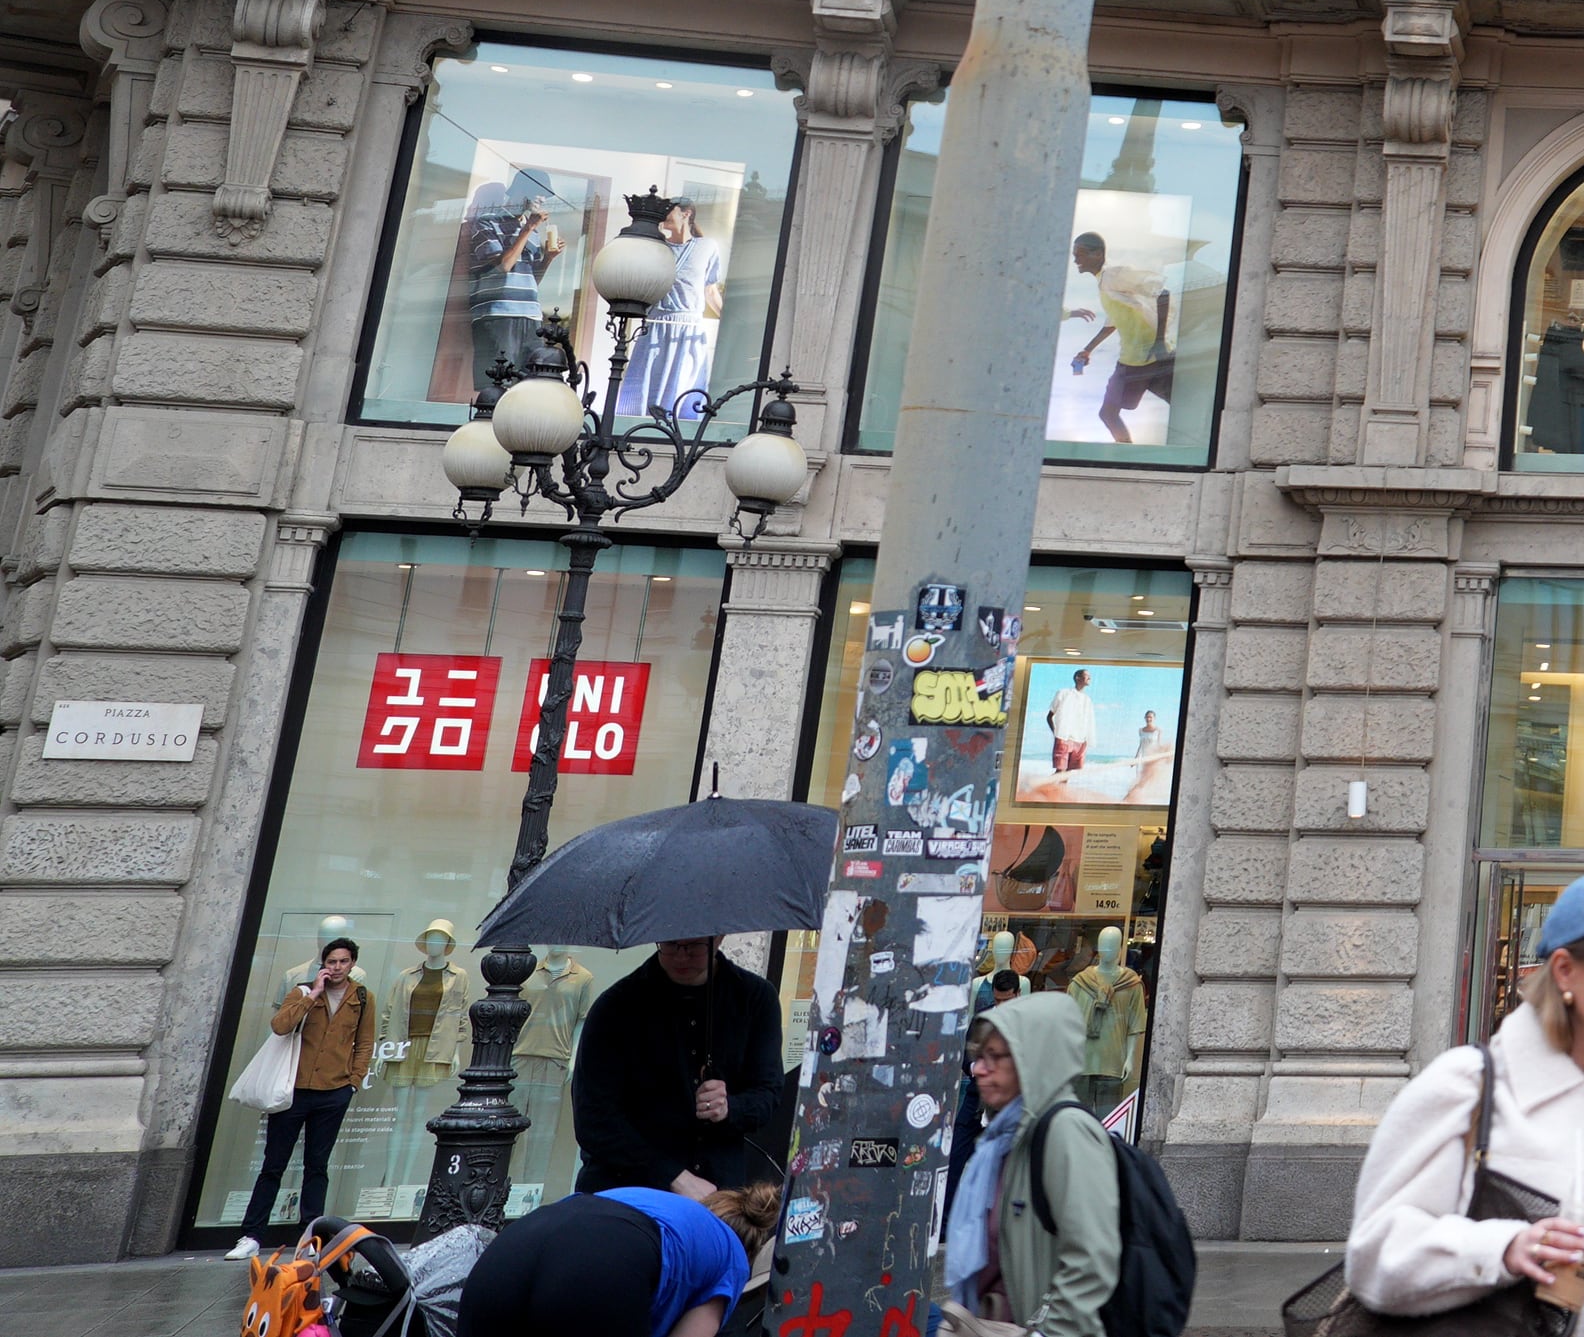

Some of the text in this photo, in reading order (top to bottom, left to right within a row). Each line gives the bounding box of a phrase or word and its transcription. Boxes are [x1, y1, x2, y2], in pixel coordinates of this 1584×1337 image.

[386, 668, 478, 707] ユニ
[104, 708, 151, 718] PIAZZA
[55, 731, 188, 747] CORDUSIO
[372, 716, 473, 755] クロ
[448, 1154, 461, 1174] 3
